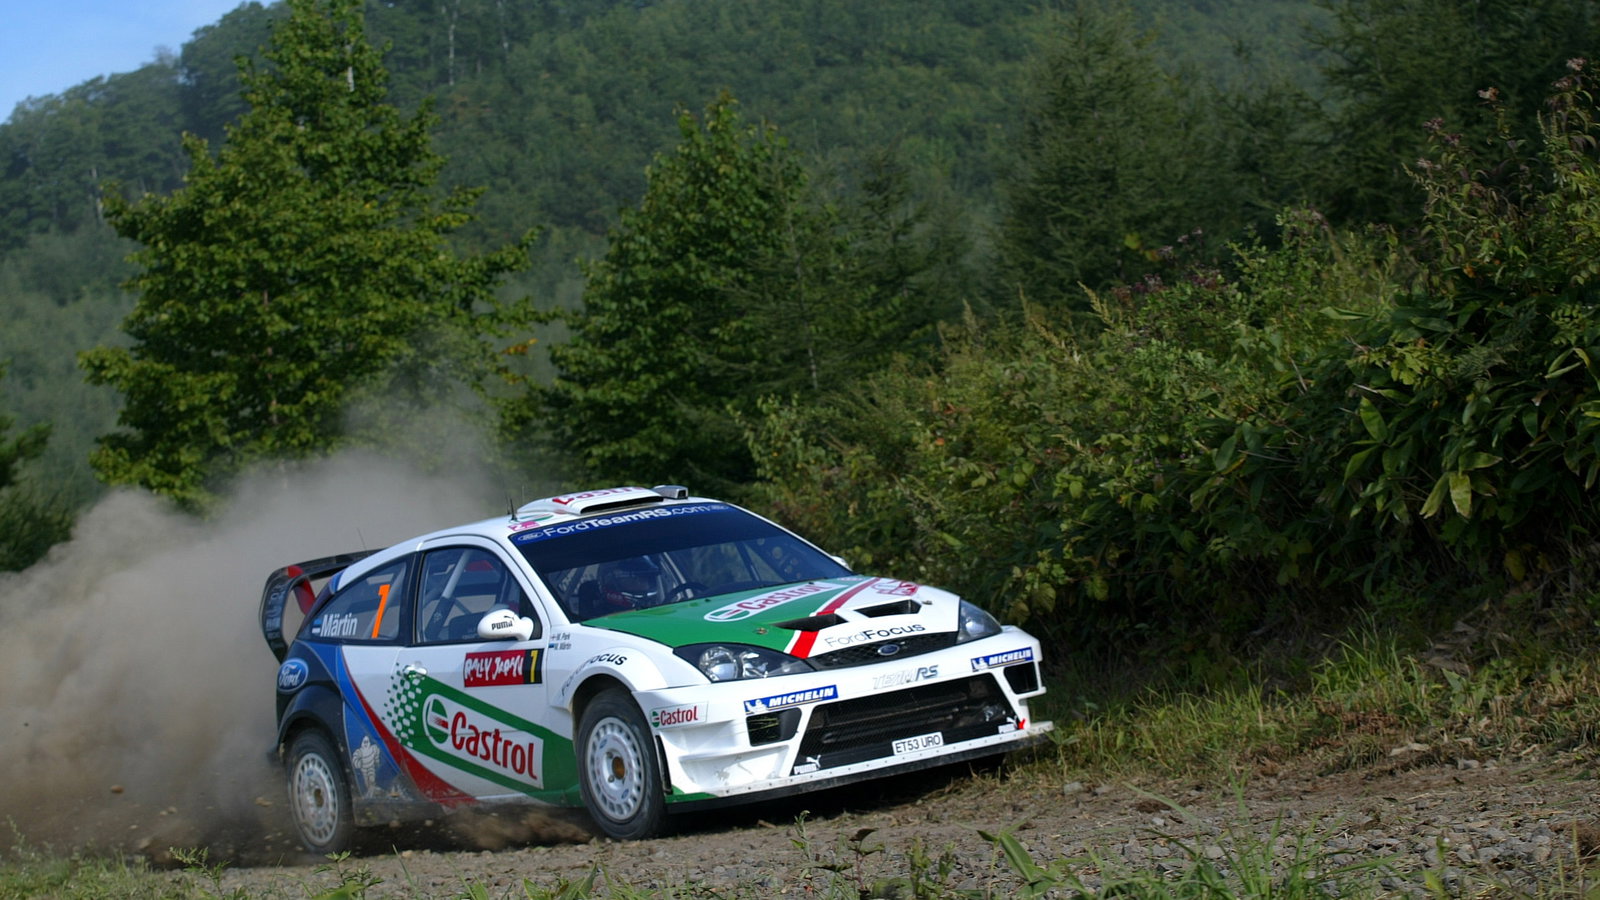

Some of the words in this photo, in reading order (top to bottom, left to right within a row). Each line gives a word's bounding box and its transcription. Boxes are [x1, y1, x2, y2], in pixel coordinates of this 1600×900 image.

[543, 505, 711, 537] FordTeamRS.com
[736, 584, 833, 610] Castrol
[371, 584, 391, 639] 1
[320, 612, 358, 637] Märtin
[825, 623, 926, 648] FordFocus
[530, 649, 539, 683] 1
[988, 649, 1032, 666] MICHELIN
[768, 686, 834, 708] MICHELIN
[660, 705, 699, 726] Castrol
[450, 711, 538, 781] Castrol
[894, 738, 921, 754] ET53
[921, 734, 942, 748] URO
